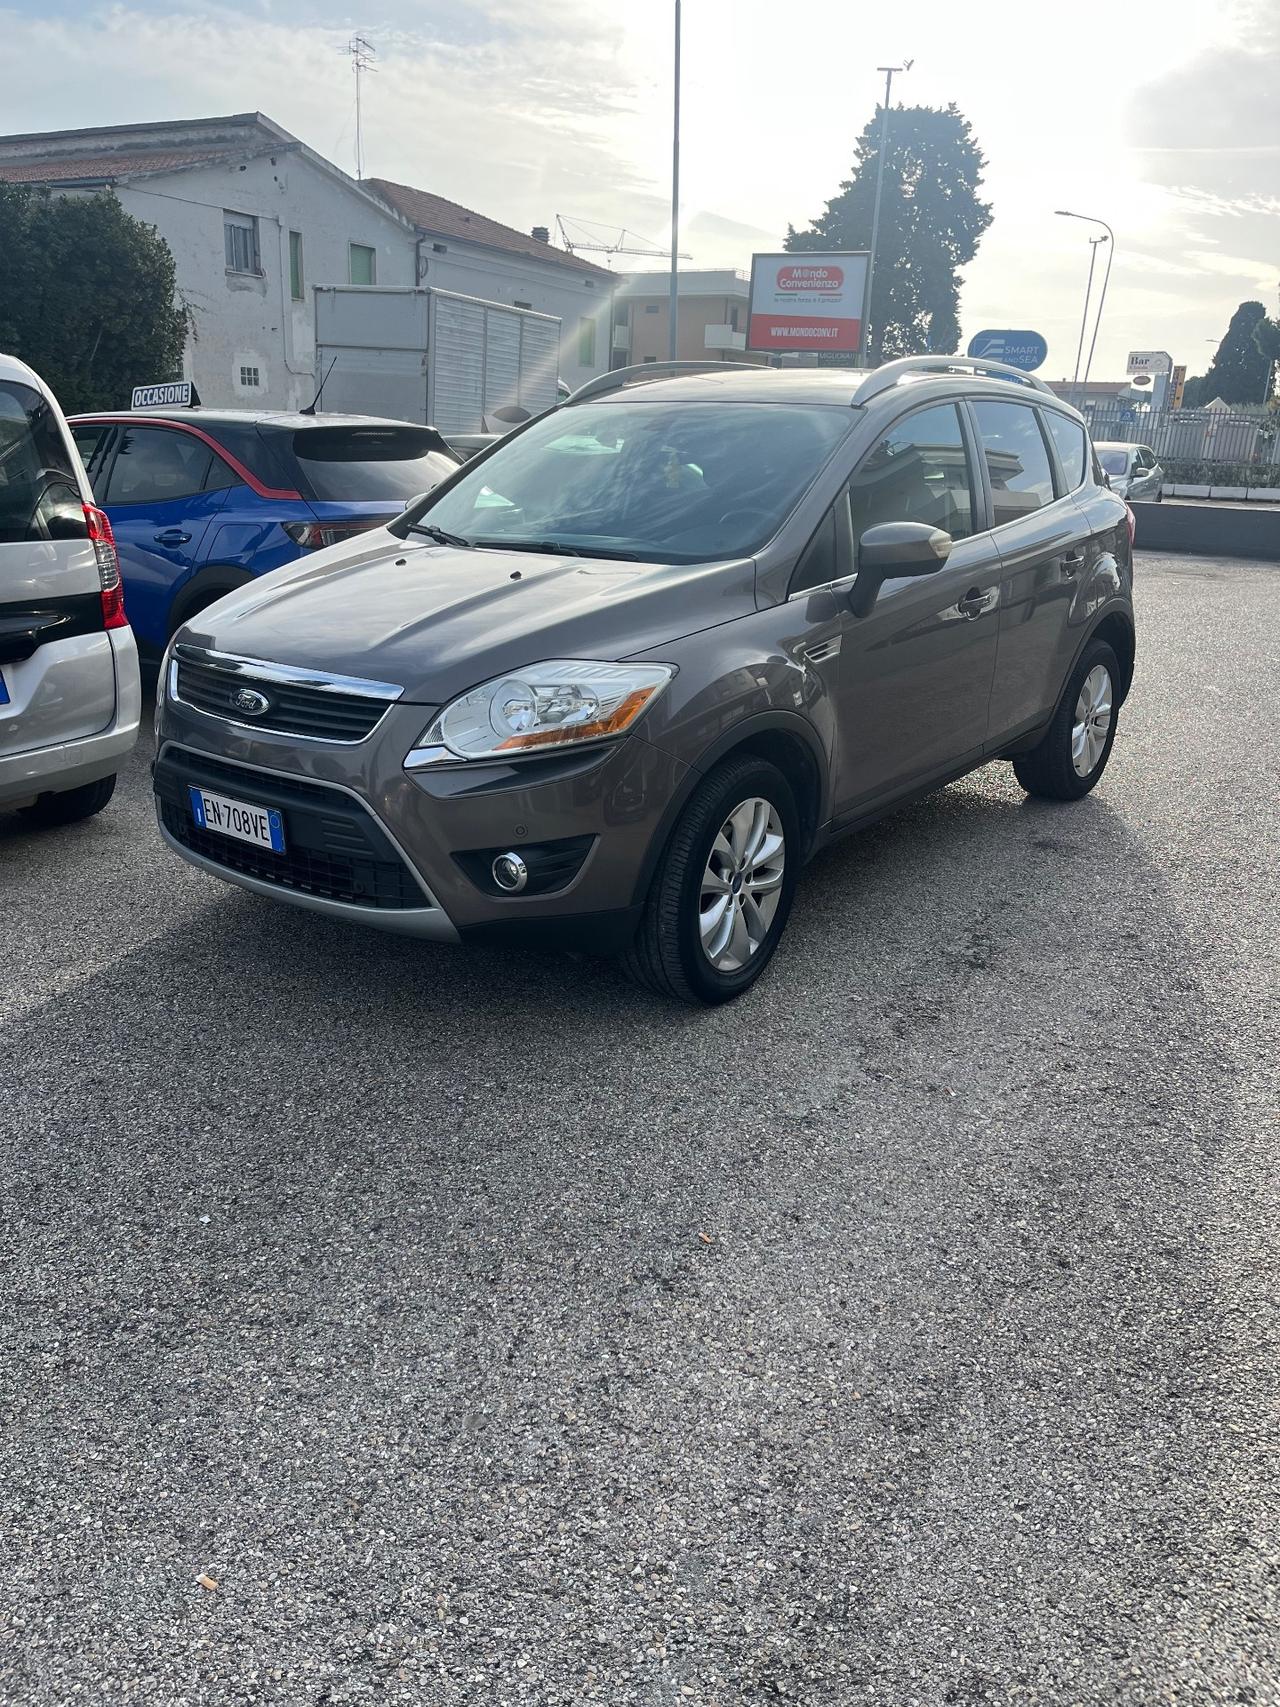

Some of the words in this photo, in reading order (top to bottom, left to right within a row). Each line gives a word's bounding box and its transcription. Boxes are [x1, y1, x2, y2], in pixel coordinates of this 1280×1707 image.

[780, 278, 839, 288] Convenienza
[771, 328, 839, 337] WWW.MONDOCONV.IT
[1005, 346, 1040, 354] SMART
[1019, 355, 1038, 364] SEA
[1130, 356, 1150, 365] Bar
[135, 385, 188, 406] OCCASIONE
[235, 693, 257, 710] Ford
